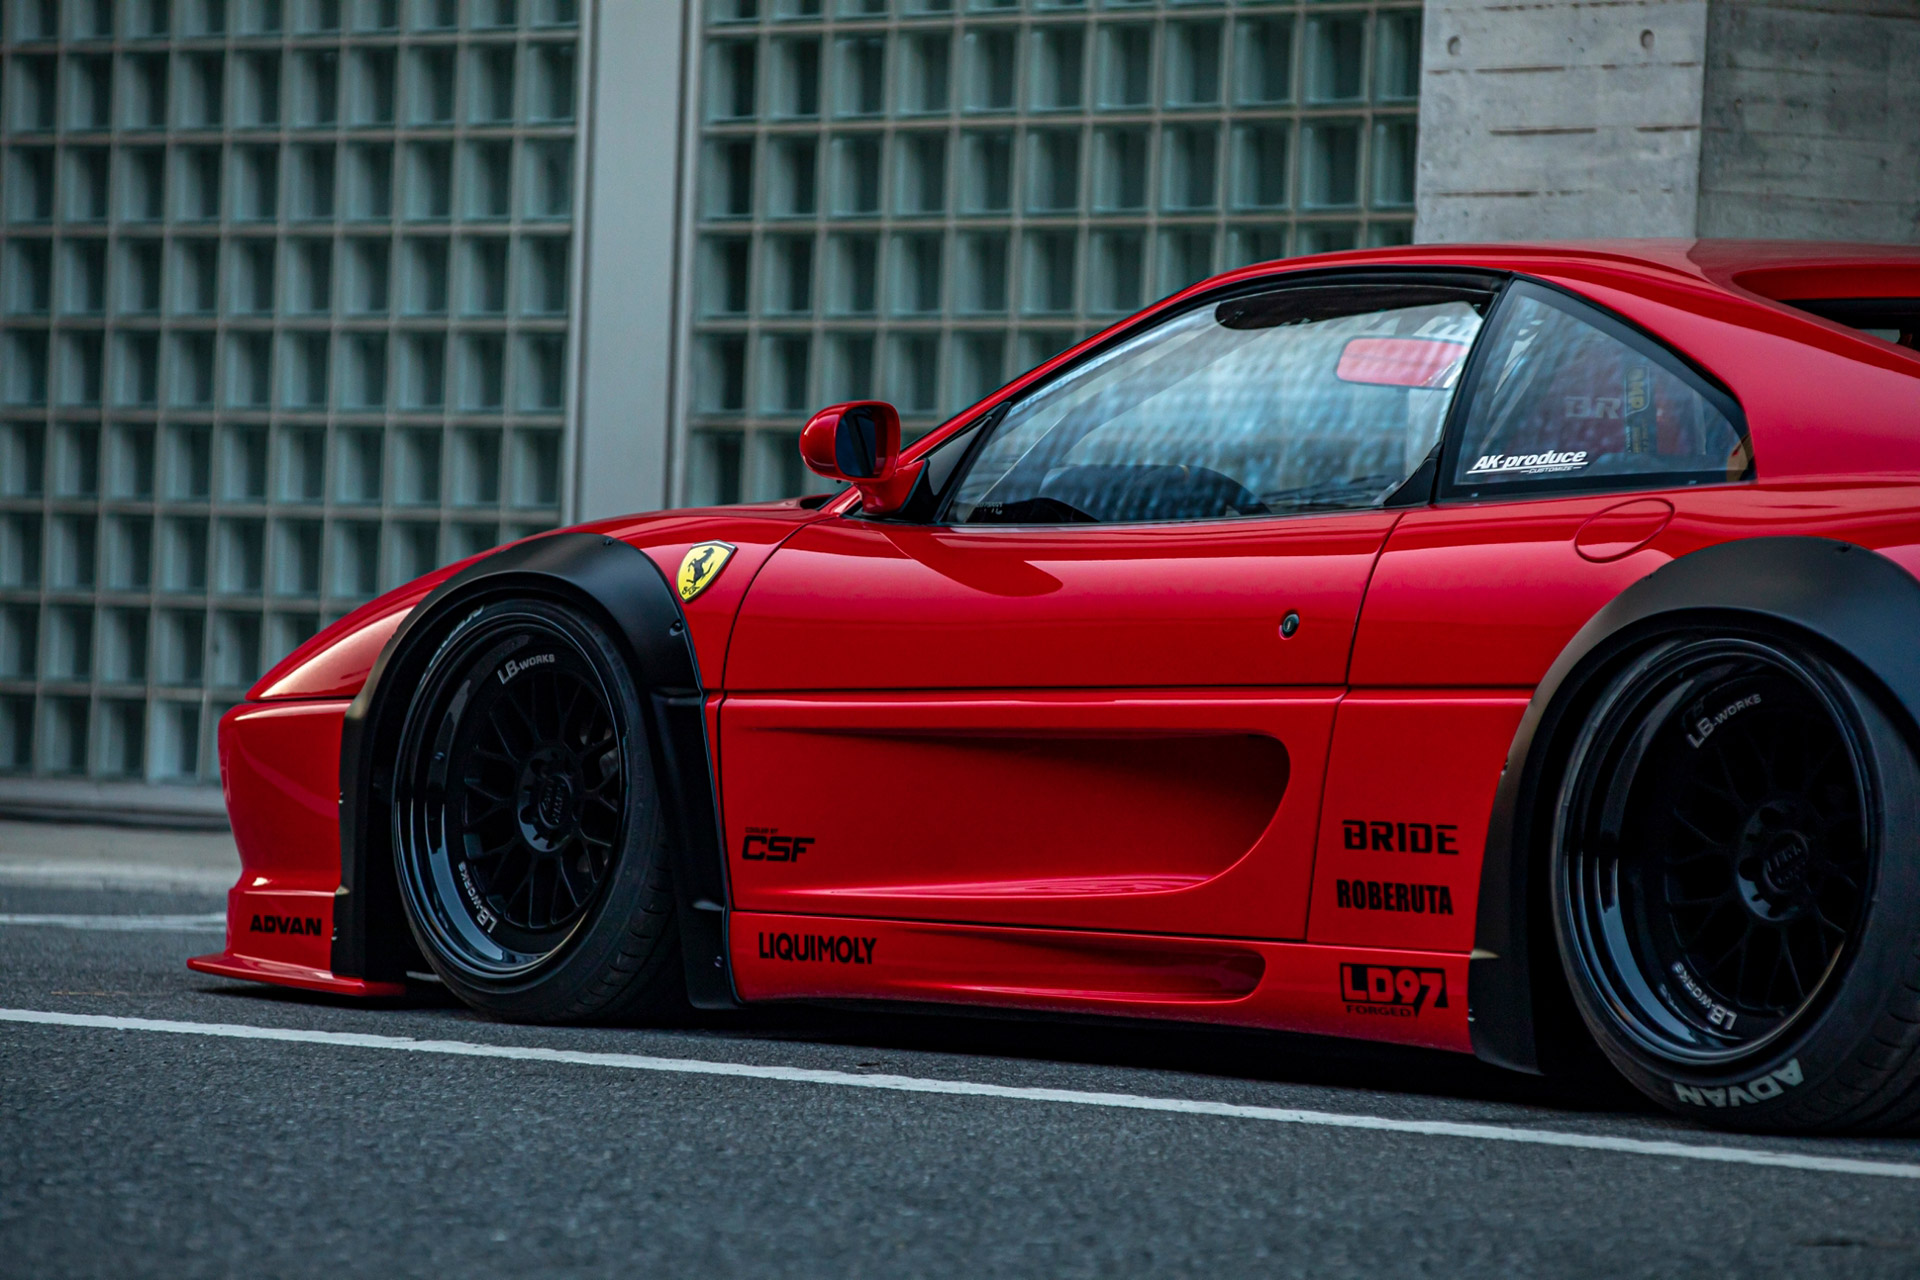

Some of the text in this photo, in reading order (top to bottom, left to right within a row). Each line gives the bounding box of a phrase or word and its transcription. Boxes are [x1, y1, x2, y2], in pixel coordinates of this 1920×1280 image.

[1471, 450, 1588, 470] AK-produce
[742, 835, 815, 862] CSF
[1342, 820, 1459, 855] BRIDE
[1337, 879, 1454, 915] ROBERUTA
[250, 914, 322, 936] ADVAN
[1342, 964, 1447, 1012] LD97
[1346, 1005, 1413, 1018] FORGED
[1675, 1057, 1806, 1108] ADVAN
